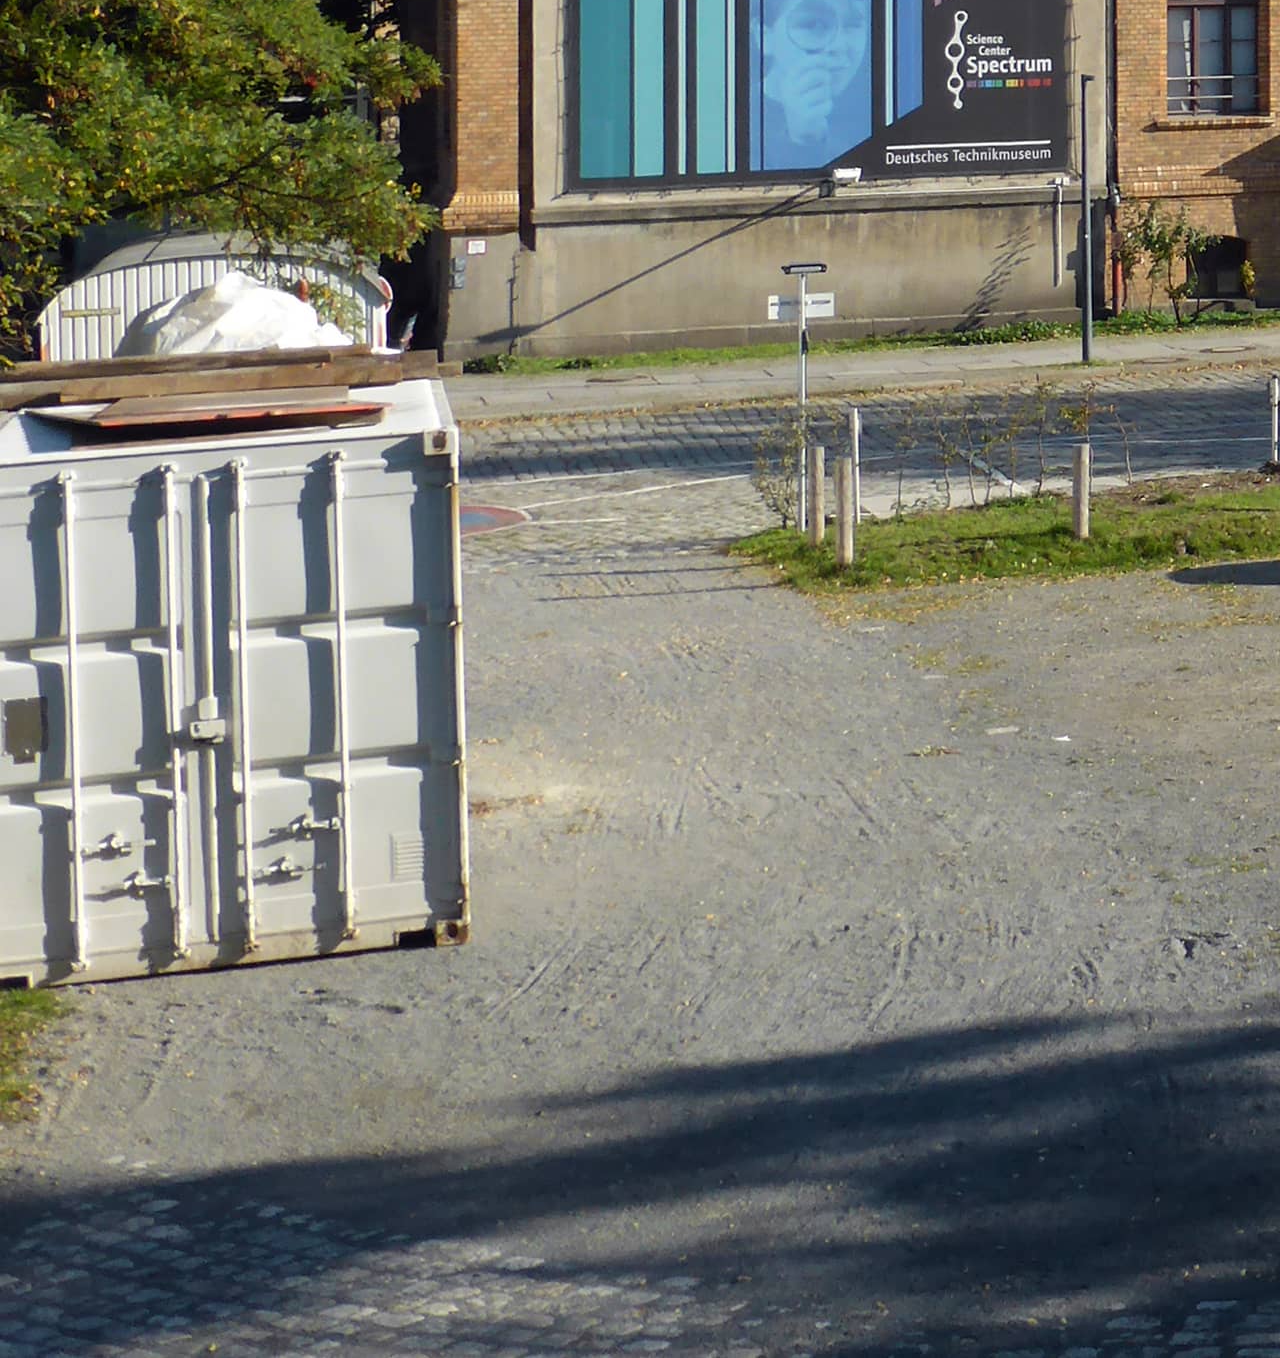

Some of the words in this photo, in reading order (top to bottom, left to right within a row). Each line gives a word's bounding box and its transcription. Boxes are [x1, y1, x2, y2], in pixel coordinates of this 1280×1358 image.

[966, 34, 1004, 45] Science
[978, 45, 1012, 56] Center
[966, 56, 1053, 77] Spectrum
[886, 150, 949, 165] Deutsches
[952, 148, 1052, 162] Technikmuseum
